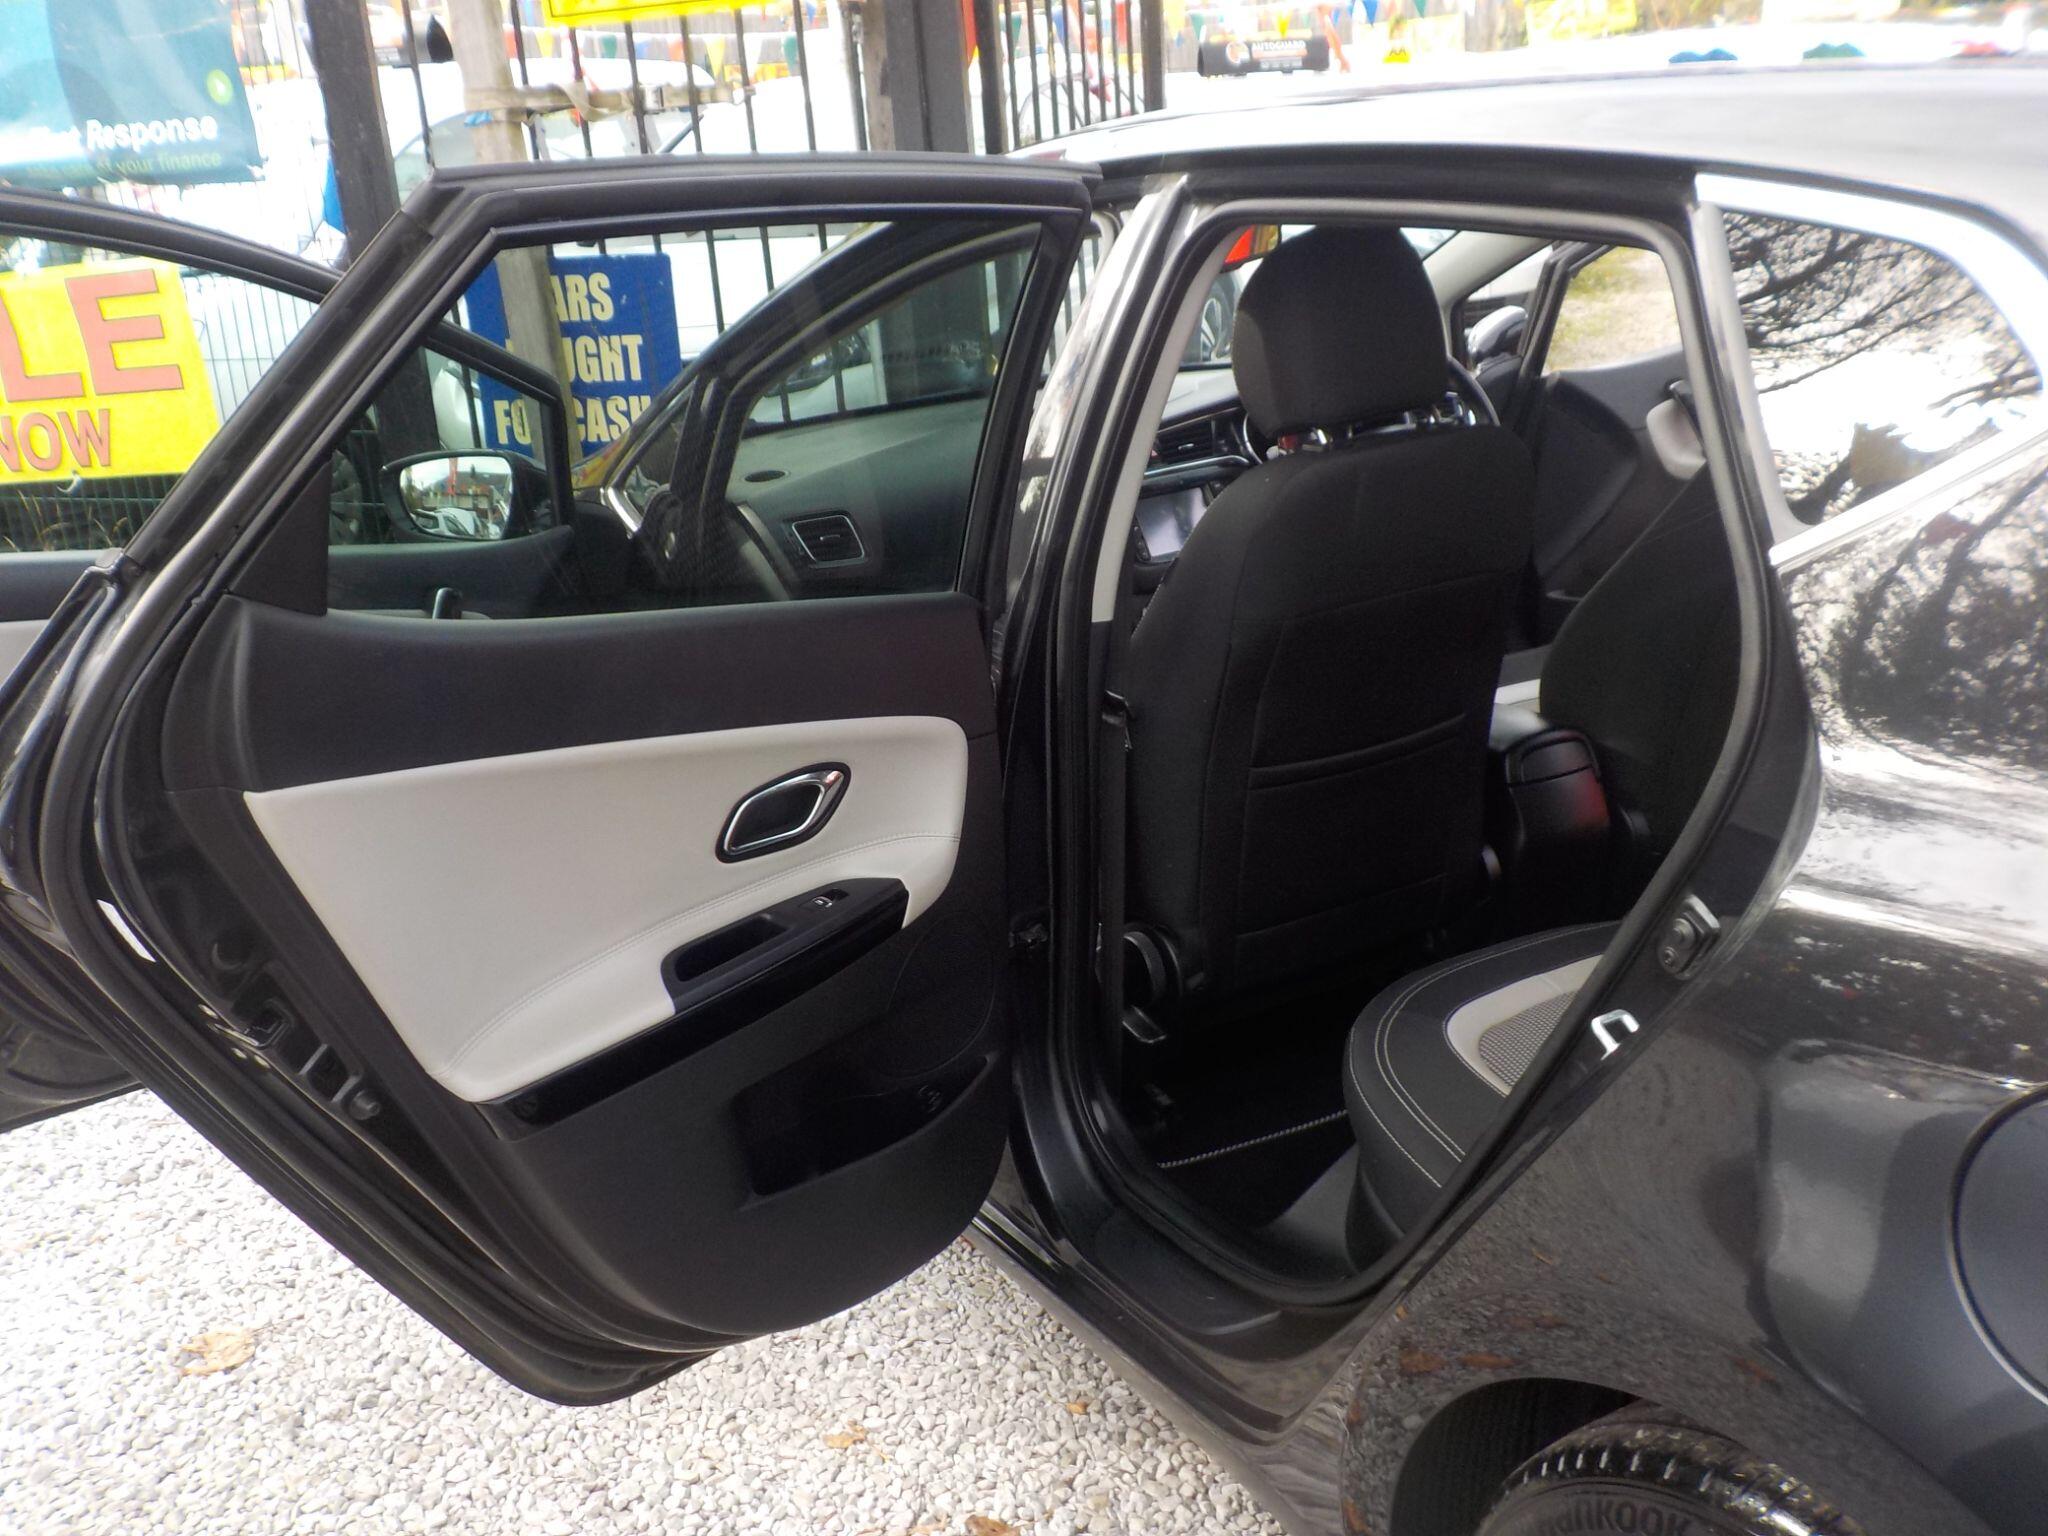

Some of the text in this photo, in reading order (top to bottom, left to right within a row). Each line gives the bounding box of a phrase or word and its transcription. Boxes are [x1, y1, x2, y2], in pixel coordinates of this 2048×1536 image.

[86, 115, 218, 152] Response
[158, 151, 222, 172] finance
[550, 272, 614, 322] ARS
[494, 399, 532, 445] FO
